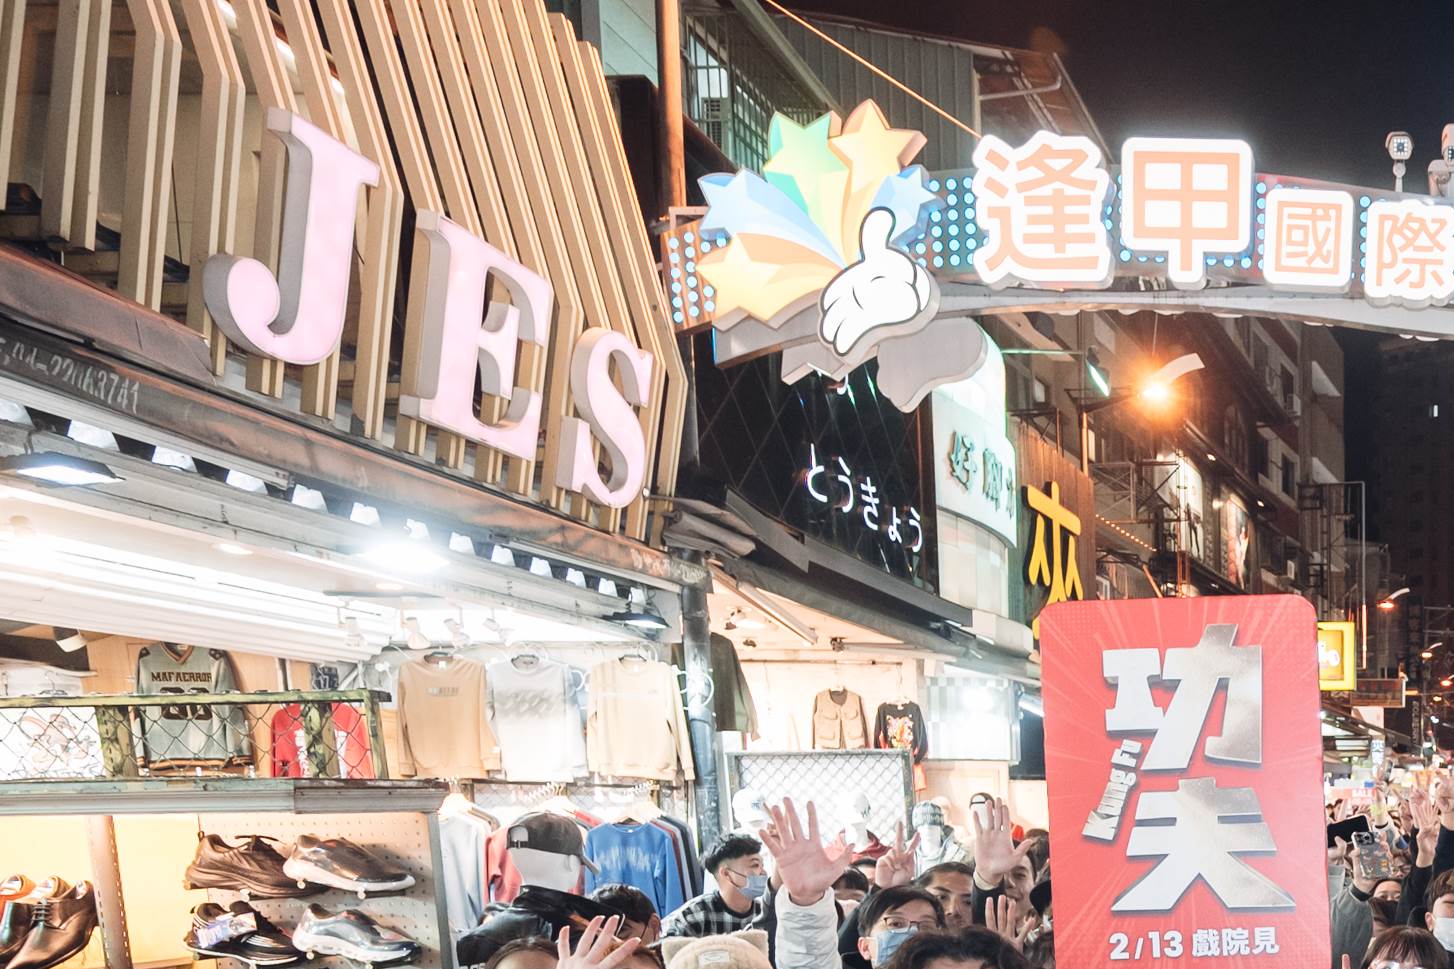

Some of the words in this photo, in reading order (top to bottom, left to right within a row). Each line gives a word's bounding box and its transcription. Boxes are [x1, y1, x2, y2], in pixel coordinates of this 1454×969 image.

[806, 443, 923, 552] とうきょう
[1109, 930, 1184, 960] 2/13
[1191, 926, 1280, 957] 戲院見
